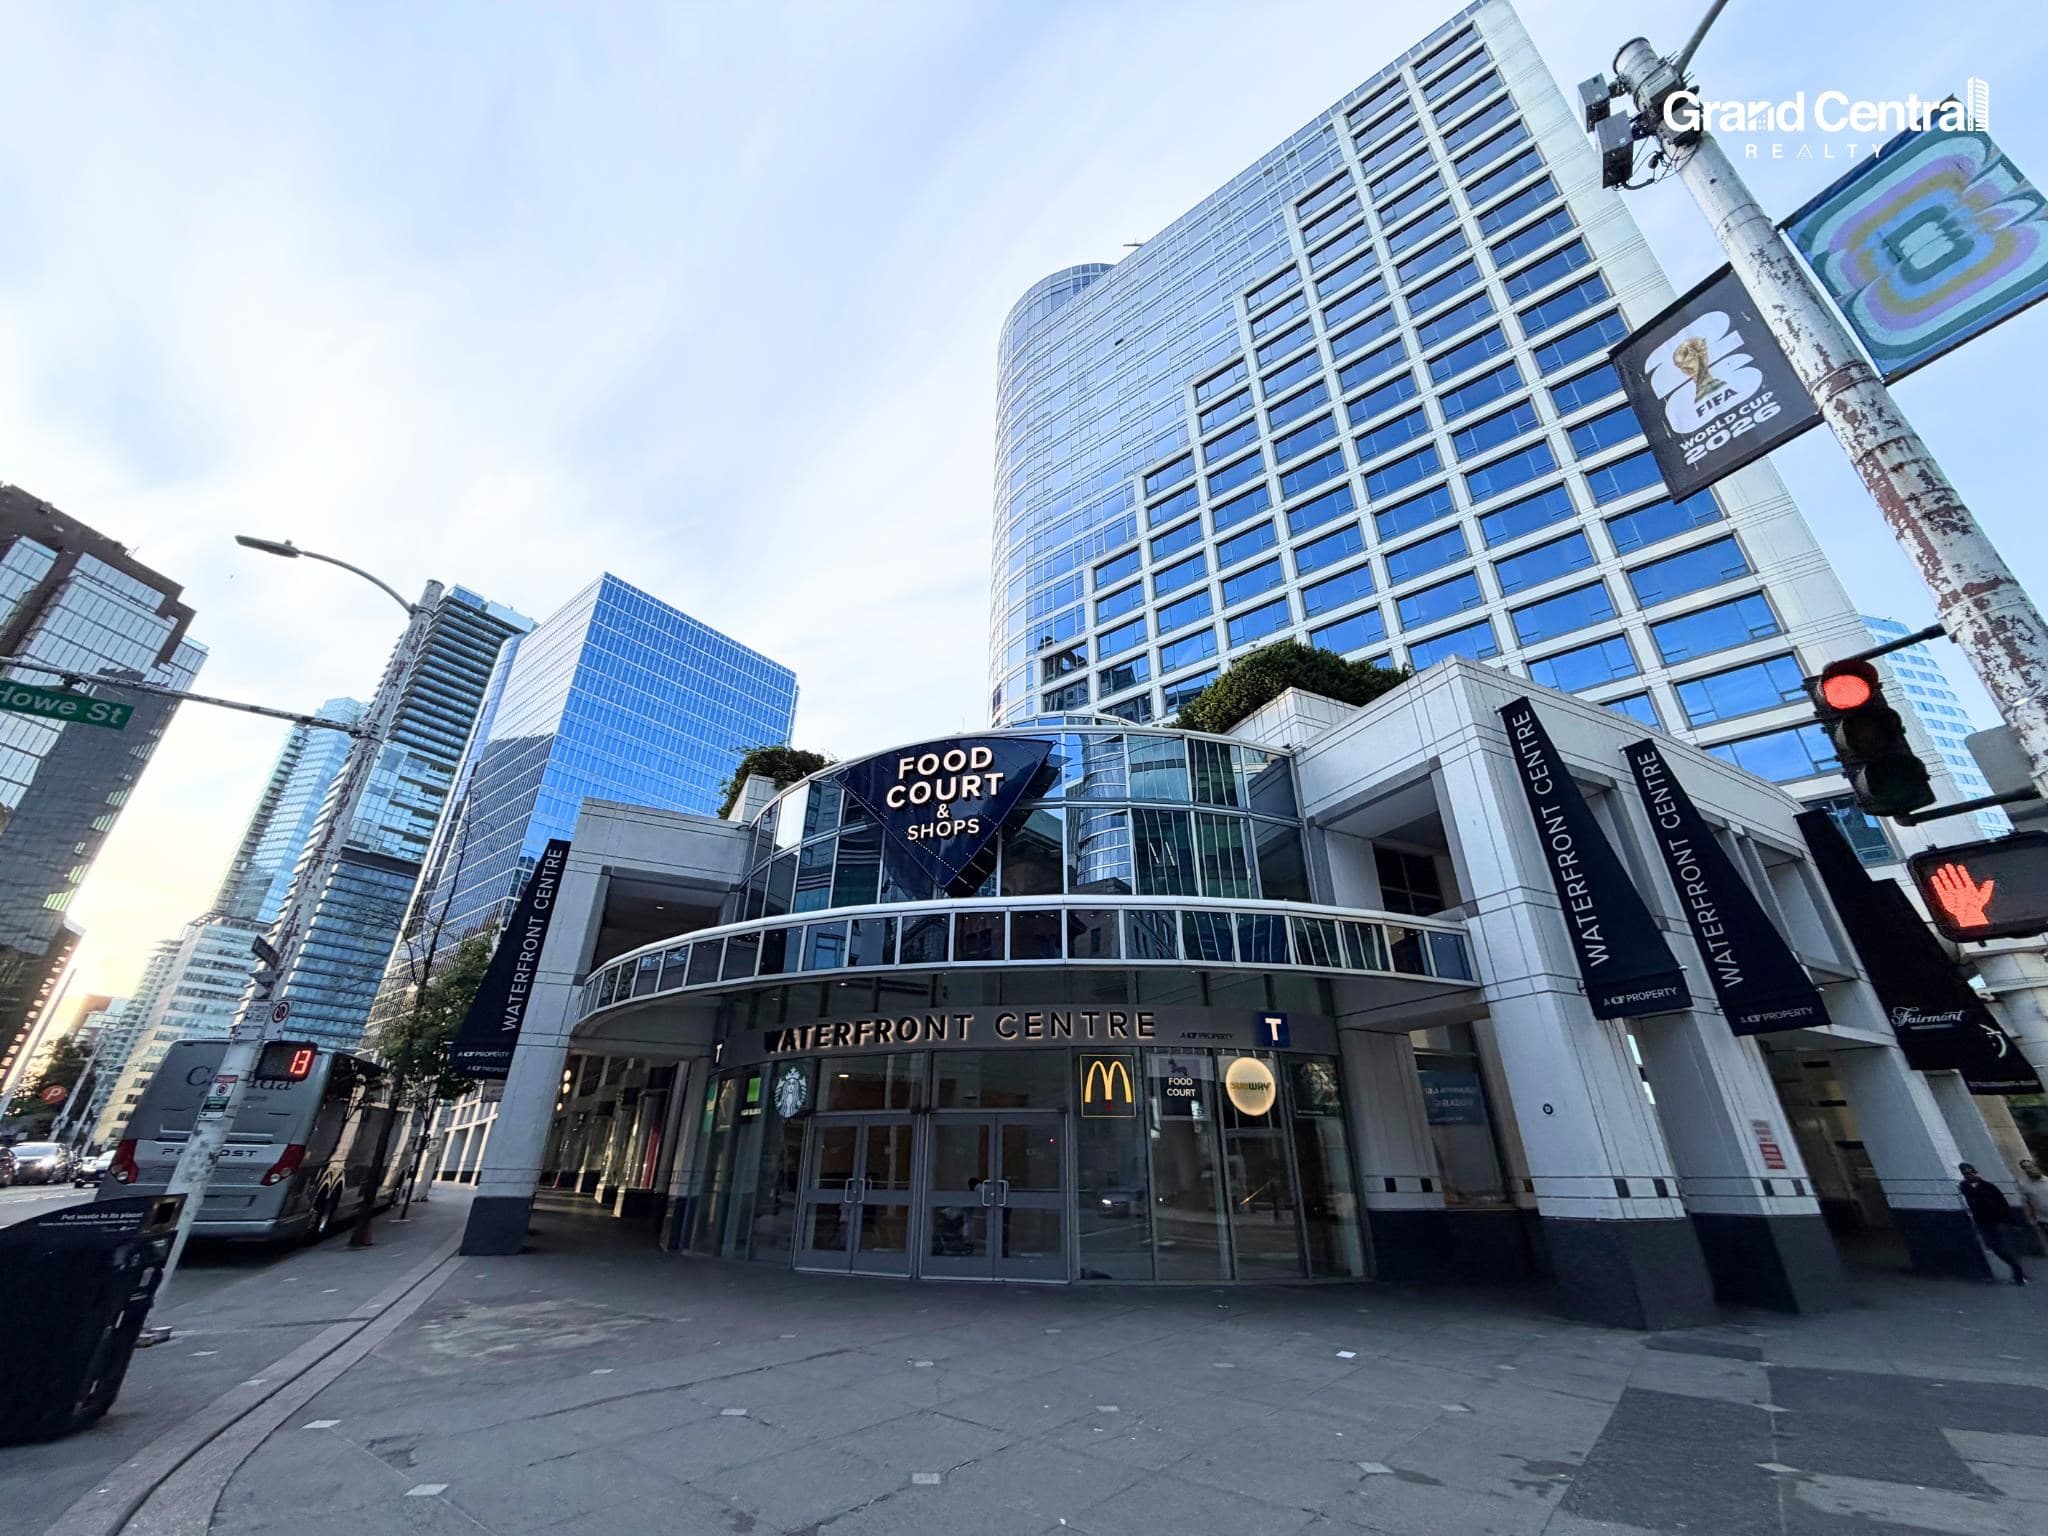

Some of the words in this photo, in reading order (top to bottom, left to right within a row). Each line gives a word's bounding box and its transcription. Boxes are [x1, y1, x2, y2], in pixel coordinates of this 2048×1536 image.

[1696, 388, 1738, 417] FIFA
[1680, 413, 1737, 450] WORLD
[1739, 391, 1773, 415] CUP
[1683, 401, 1781, 465] 2026
[0, 686, 77, 715] Howe
[87, 702, 123, 724] St
[898, 746, 993, 780] FOOD
[1512, 710, 1553, 795] CENTRE
[886, 772, 1004, 808] COURT
[1637, 750, 1681, 829] CENTRE
[936, 803, 950, 819] &
[907, 818, 980, 841] SHOPS
[1541, 804, 1610, 968] WATERFRONT
[1669, 838, 1744, 988] WATERFRONT
[501, 915, 545, 1031] WATERFRONT
[534, 848, 563, 910] CENTRE
[1626, 987, 1678, 1002] PROPERTY
[995, 1010, 1157, 1040] CENTRE
[1762, 1007, 1814, 1020] PROPERTY
[1891, 1007, 1966, 1027] Fairmont
[1264, 1017, 1282, 1041] T
[1166, 1088, 1196, 1098] COURT
[1168, 1077, 1193, 1086] FOOD
[1231, 1081, 1272, 1091] SUBWAY
[162, 1148, 258, 1158] PROST
